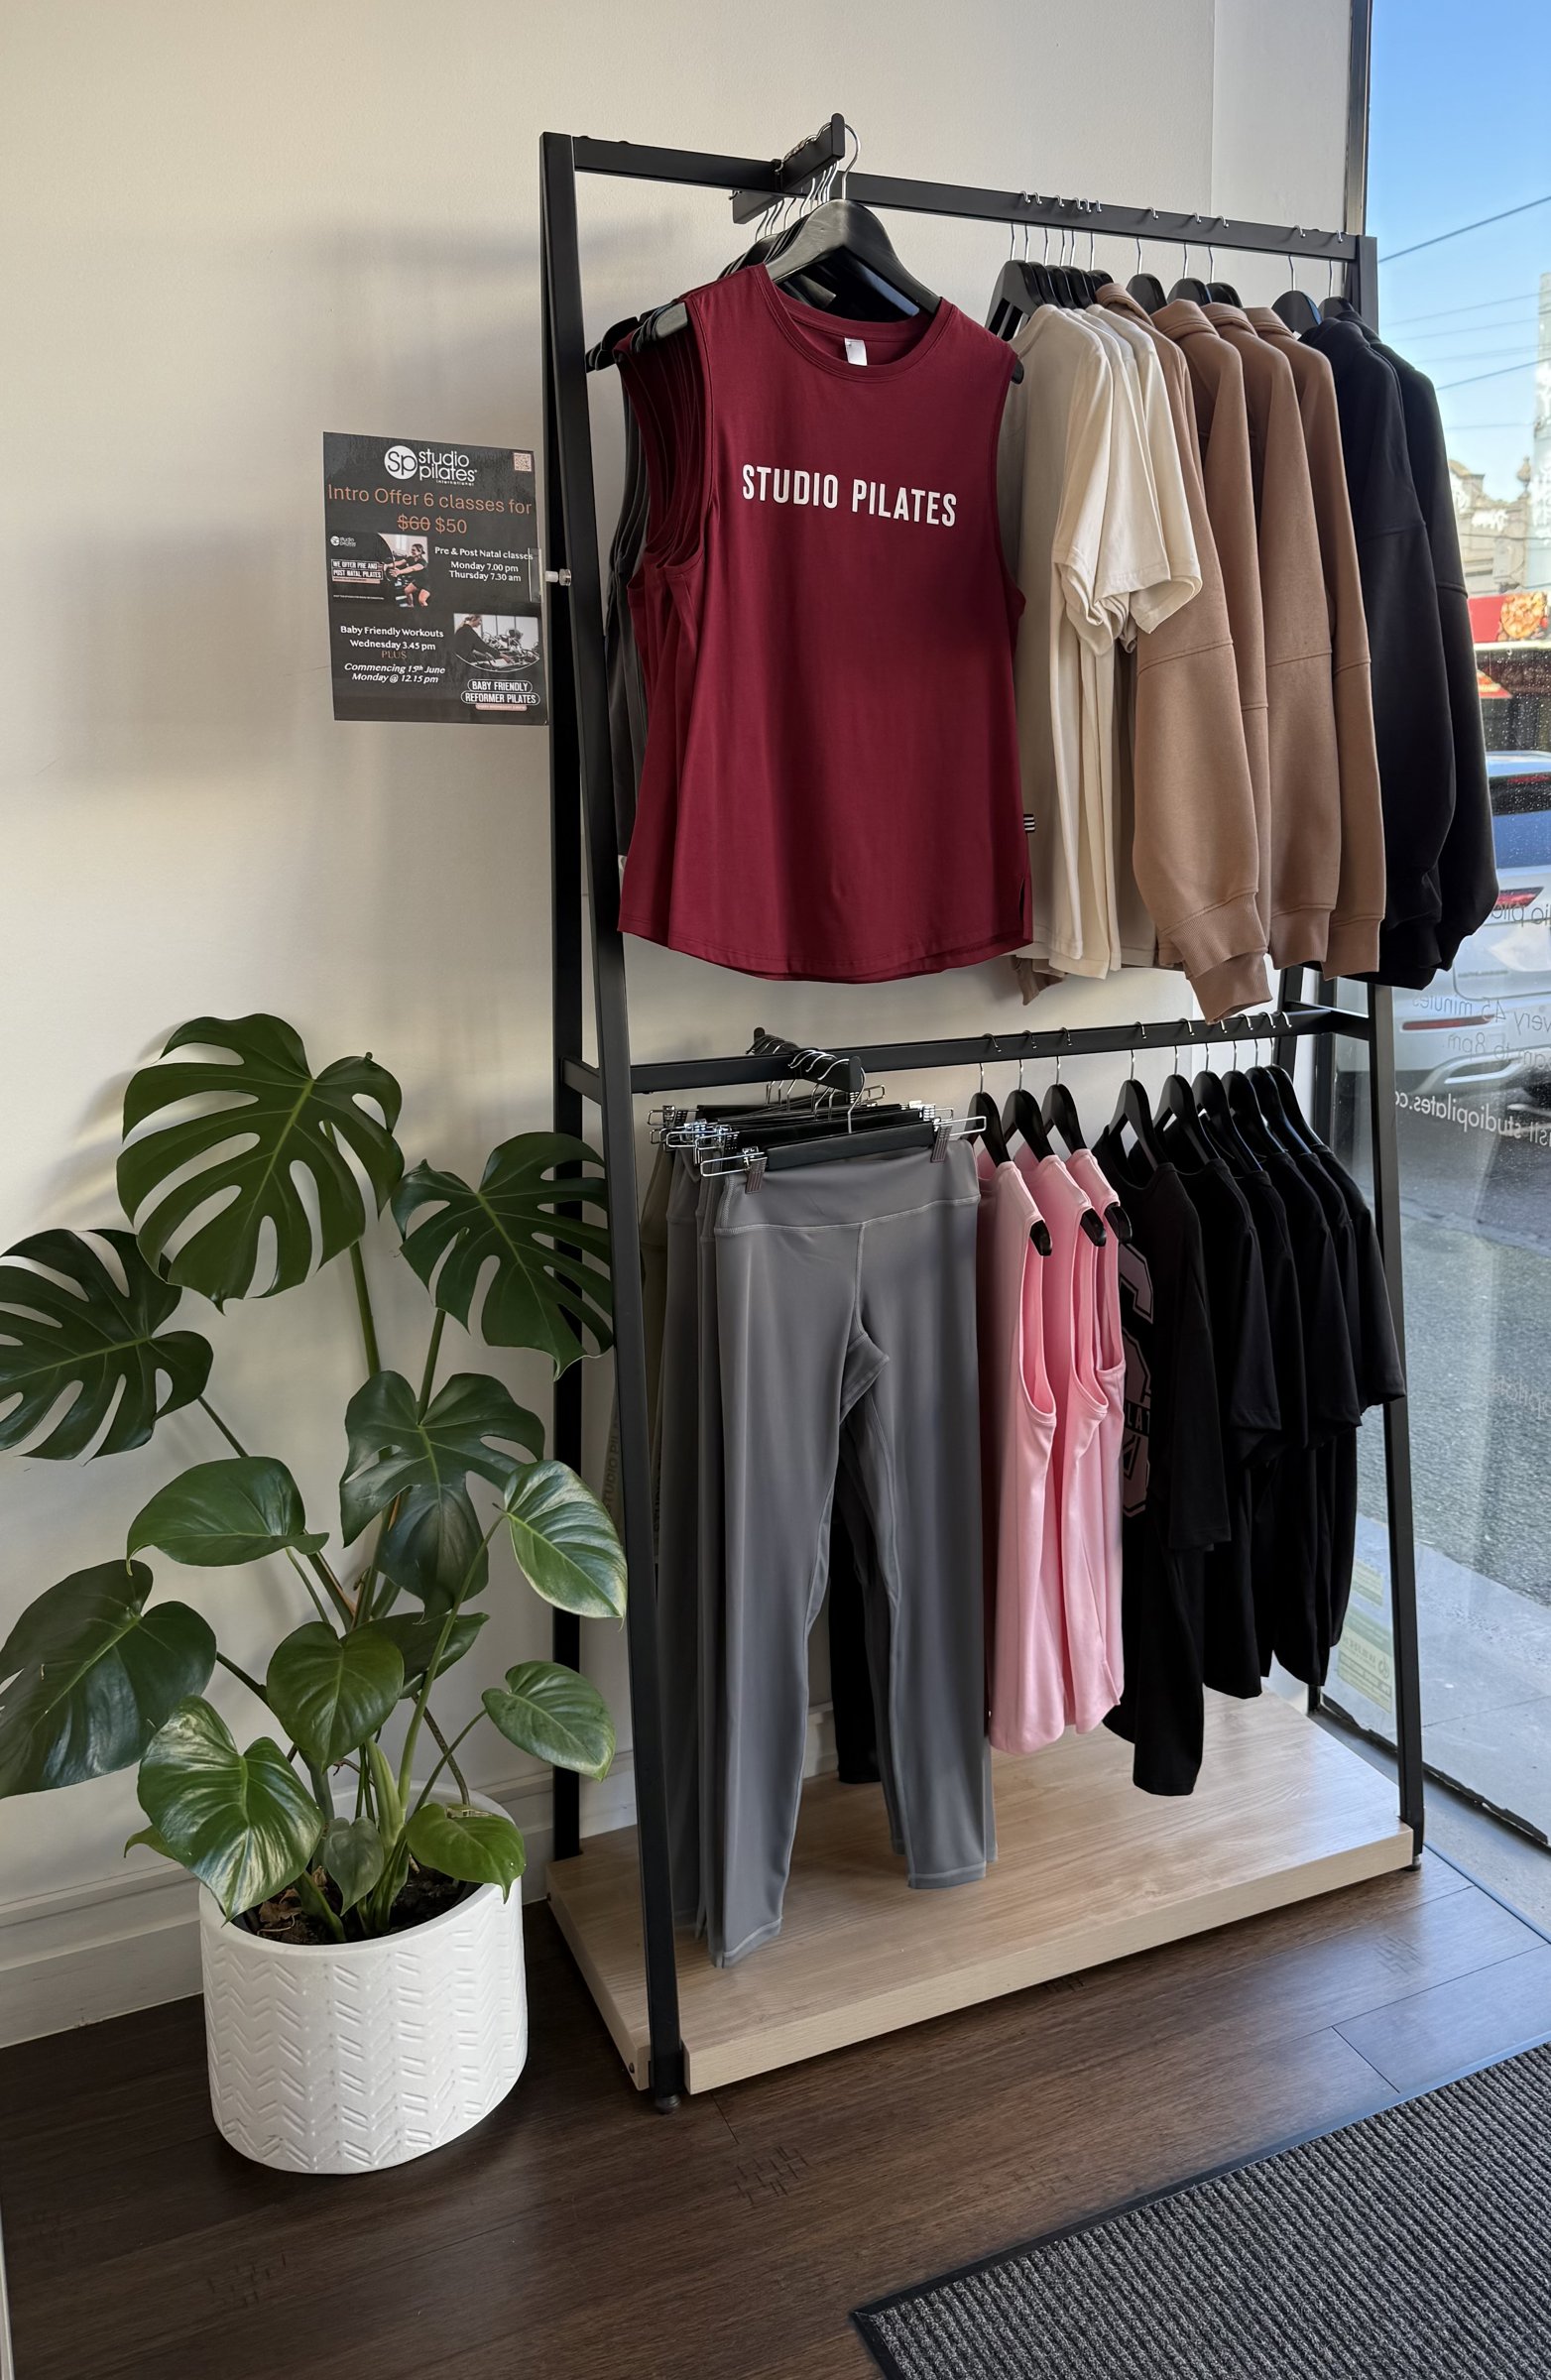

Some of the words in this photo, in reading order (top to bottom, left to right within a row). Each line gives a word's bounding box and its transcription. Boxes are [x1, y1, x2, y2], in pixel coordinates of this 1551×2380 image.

[418, 448, 470, 467] studio
[419, 464, 476, 482] pilates
[328, 483, 370, 502] Intro
[374, 488, 419, 506] Offer
[423, 492, 434, 507] 6
[438, 494, 505, 513] classes
[508, 499, 533, 515] for
[742, 463, 839, 510] STUDIO
[851, 478, 958, 528] PILATES
[397, 513, 431, 532] $60
[435, 517, 467, 535] $50
[459, 547, 478, 557] Post
[479, 549, 502, 558] Natal
[503, 550, 534, 560] classes
[450, 560, 485, 572] Monday
[505, 564, 519, 573] pm
[448, 569, 489, 582] Thursday
[490, 572, 507, 581] 7.30
[340, 625, 363, 636] Baby
[364, 626, 401, 638] Friendly
[401, 628, 444, 638] Workouts
[349, 639, 402, 651] Wednesday
[420, 643, 436, 652] pm
[381, 650, 408, 659] PLUS
[344, 662, 407, 674] Commencing
[423, 665, 446, 674] June
[351, 672, 389, 683] Monday
[389, 673, 399, 683] @
[401, 674, 422, 683] 12.15
[422, 675, 439, 684] pm
[471, 680, 492, 690] BABY
[494, 681, 529, 692] FRIENDLY
[465, 692, 505, 703] REFORMER
[507, 693, 537, 704] PILATES
